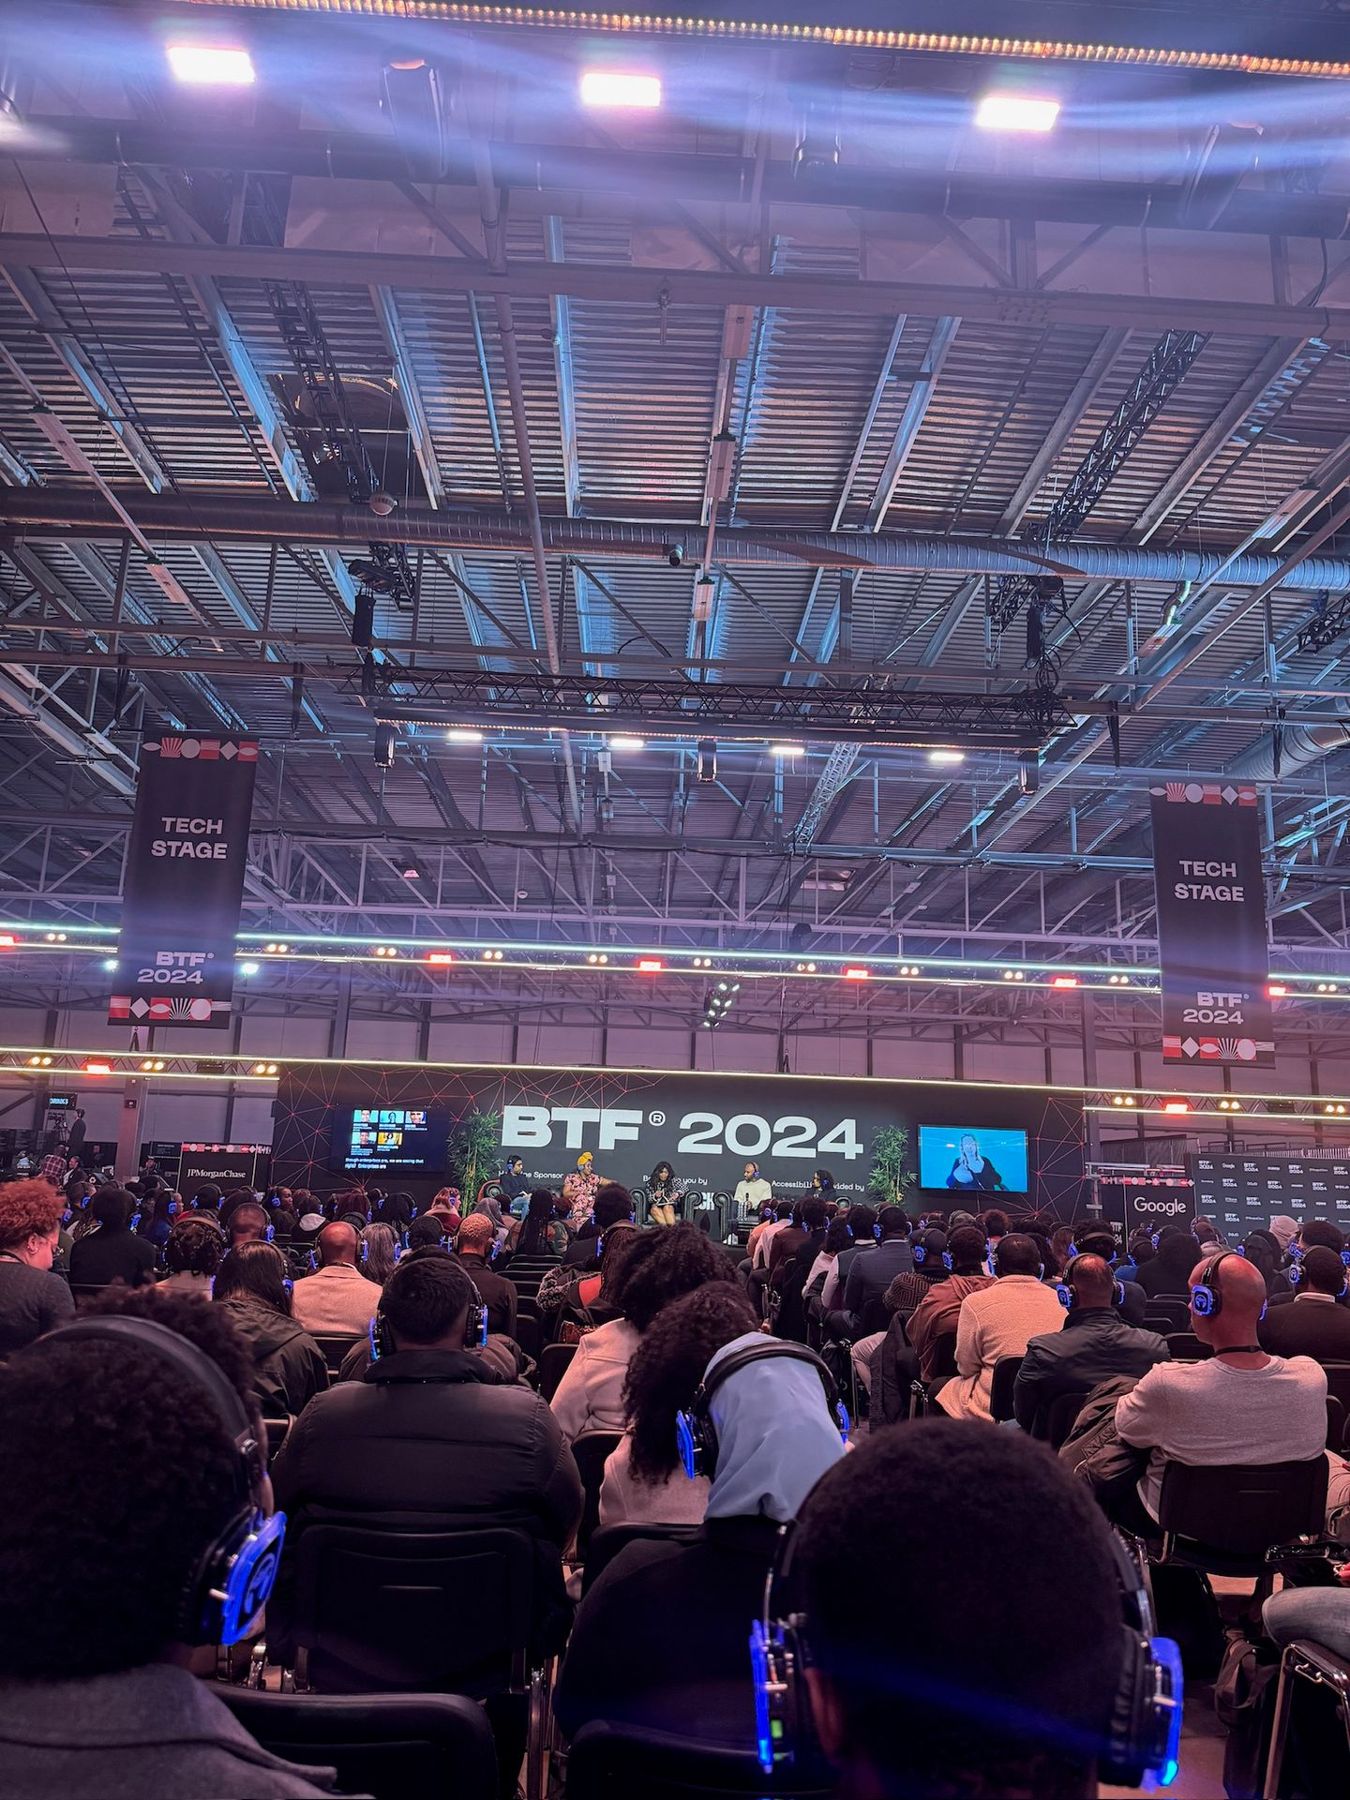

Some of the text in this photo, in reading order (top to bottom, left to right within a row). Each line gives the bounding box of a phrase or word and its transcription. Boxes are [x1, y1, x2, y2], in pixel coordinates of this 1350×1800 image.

[161, 817, 223, 835] TECH
[151, 840, 228, 859] STAGE
[1179, 860, 1237, 878] TECH
[1174, 883, 1245, 902] STAGE
[137, 969, 204, 984] 2024
[1183, 1009, 1244, 1025] 2024
[677, 1112, 864, 1160] 2024
[187, 1169, 246, 1179] JPMorganChase
[533, 1171, 564, 1179] Sponsor
[698, 1177, 708, 1186] by
[855, 1184, 865, 1192] by
[1133, 1196, 1187, 1216] Google
